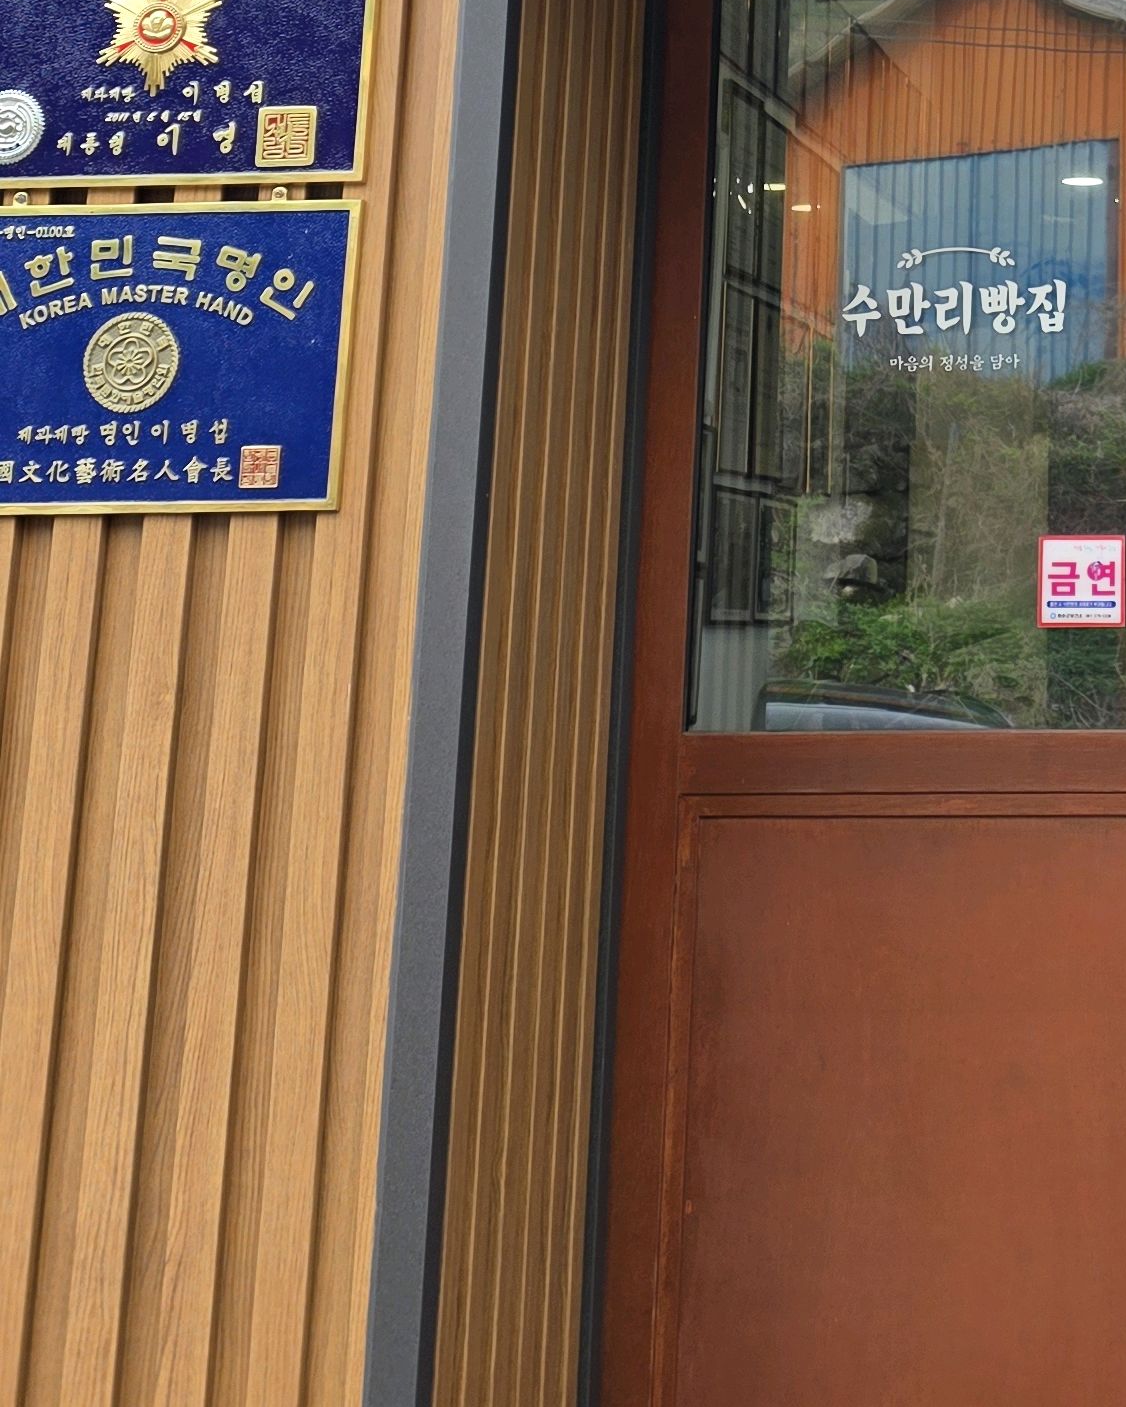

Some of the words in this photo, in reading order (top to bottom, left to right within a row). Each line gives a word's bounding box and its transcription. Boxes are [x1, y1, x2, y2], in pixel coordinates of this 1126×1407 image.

[18, 292, 93, 330] KOREA
[101, 284, 188, 306] MASTER
[195, 291, 254, 326] HAND
[842, 278, 1067, 338] 수만리빵집
[889, 354, 933, 372] 마음의
[940, 353, 985, 372] 정성을
[990, 353, 1021, 371] 담아
[100, 420, 141, 446] 명인
[1048, 561, 1115, 597] 금연
